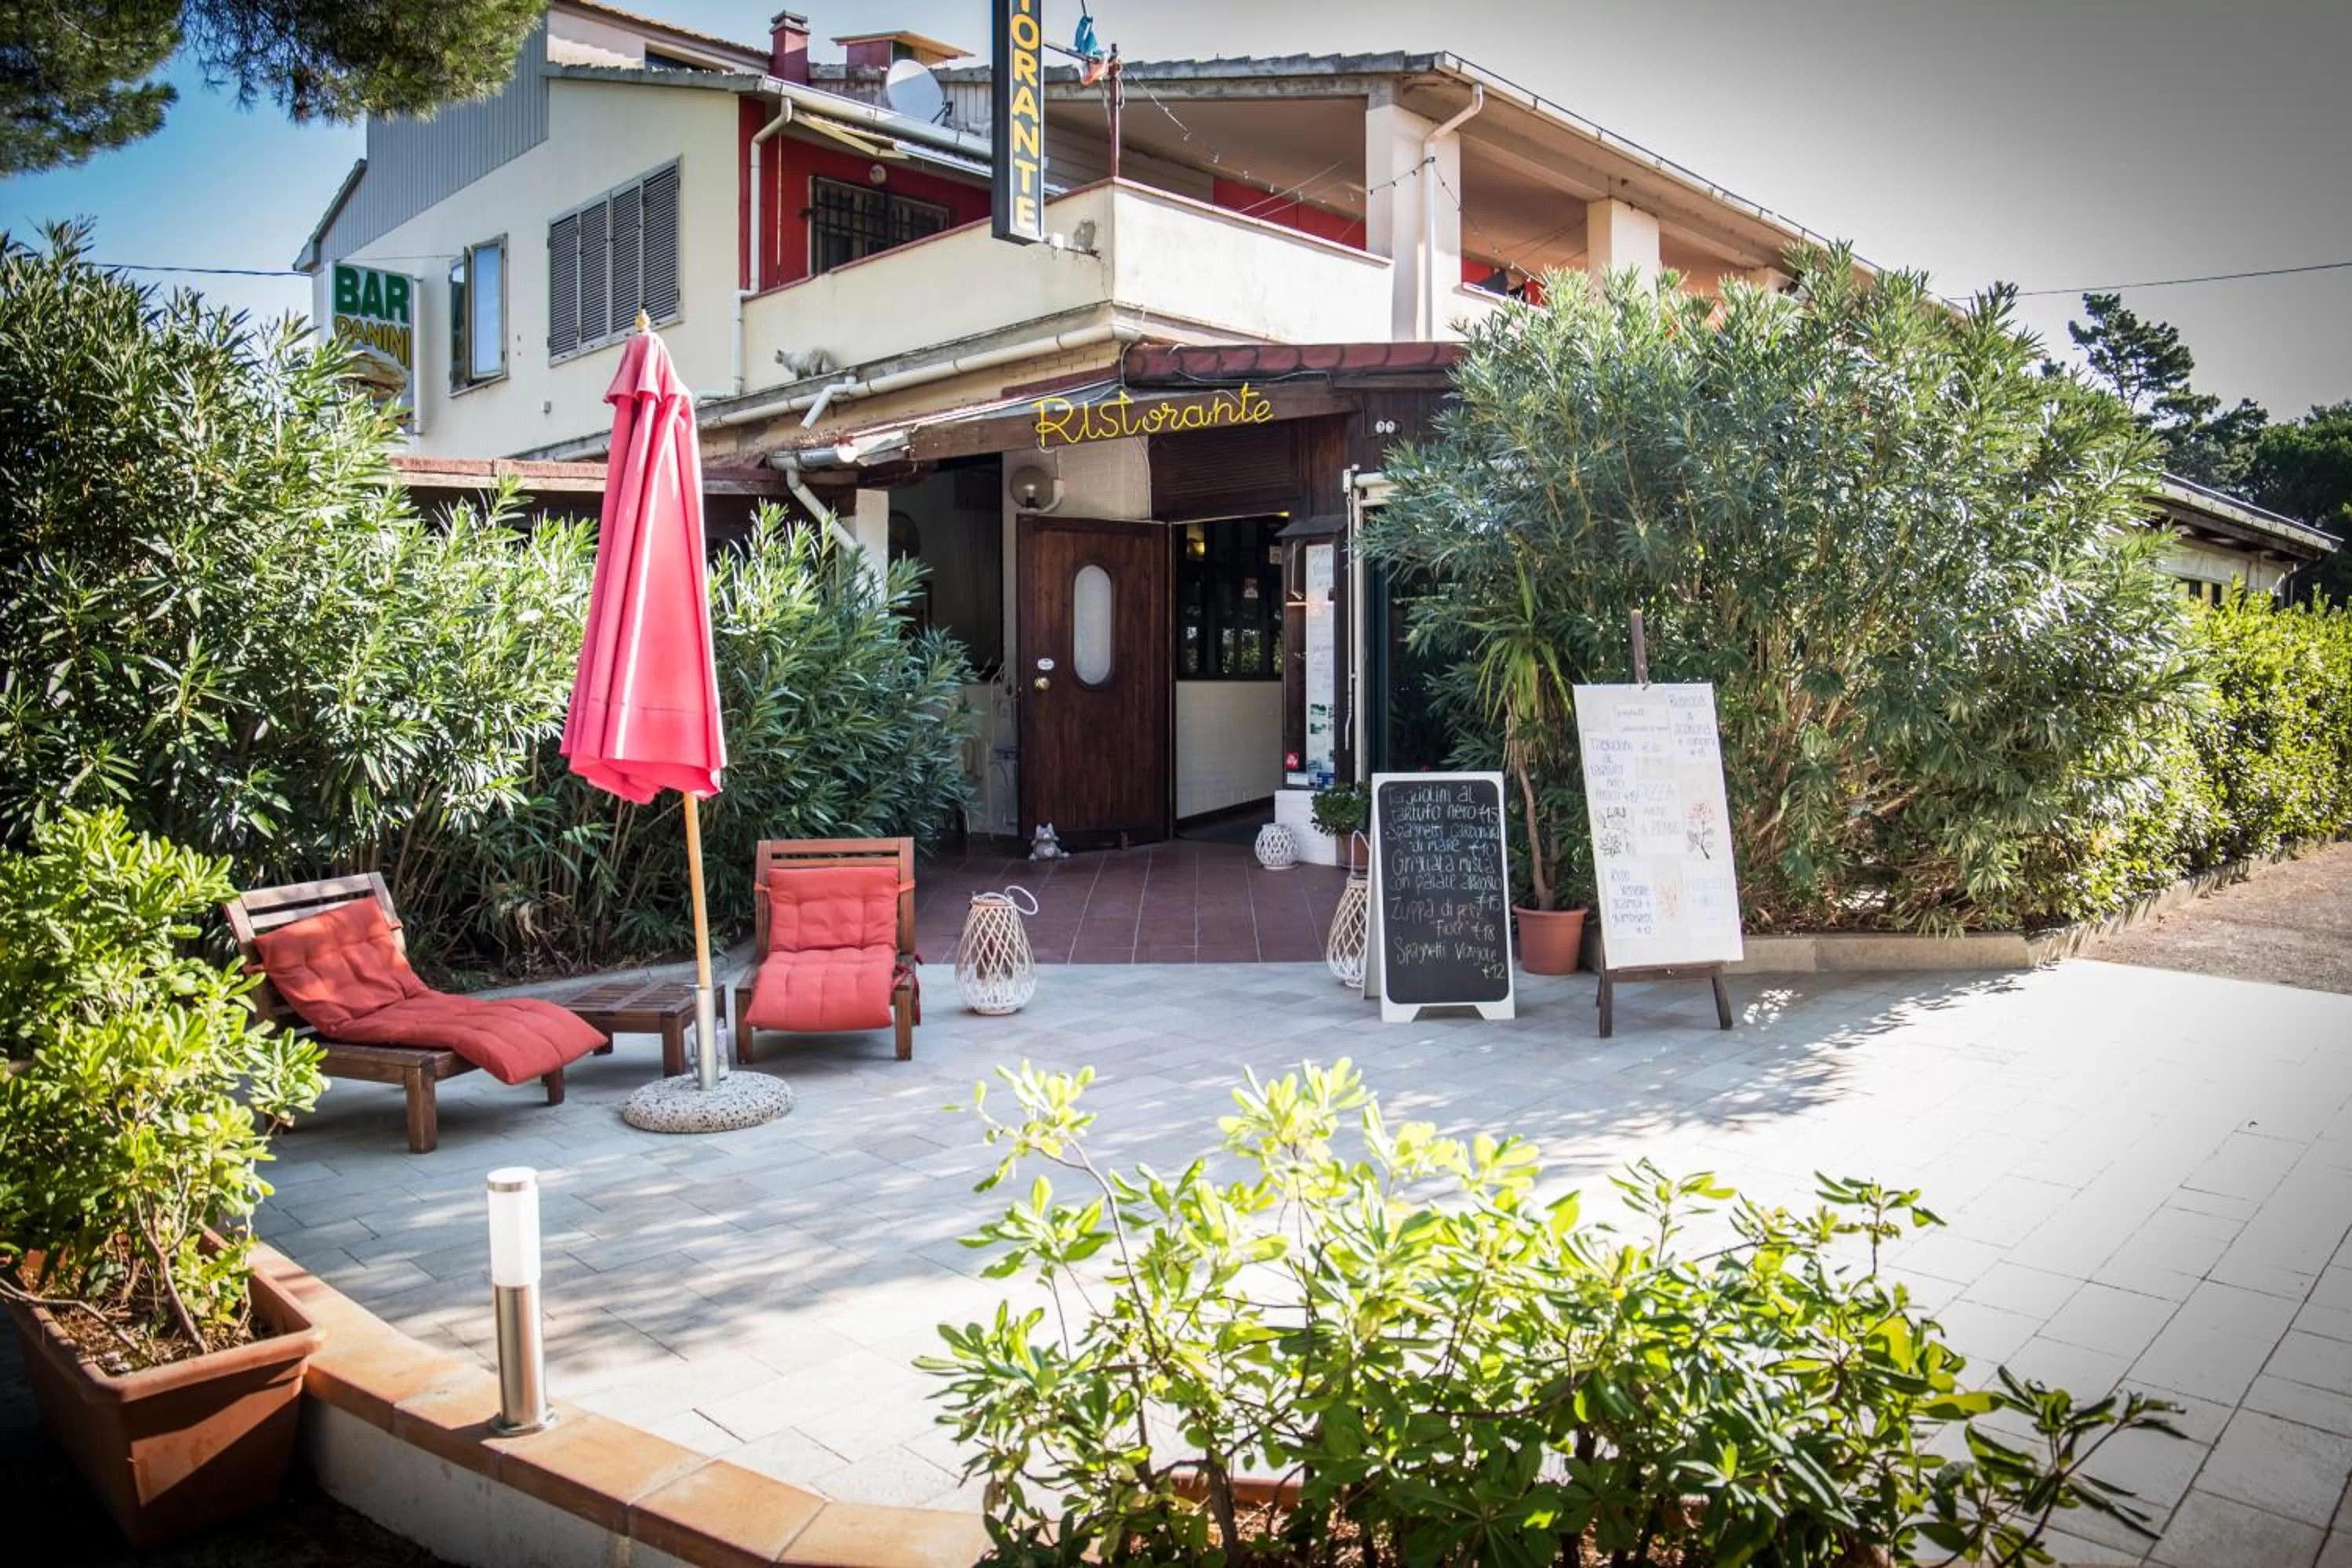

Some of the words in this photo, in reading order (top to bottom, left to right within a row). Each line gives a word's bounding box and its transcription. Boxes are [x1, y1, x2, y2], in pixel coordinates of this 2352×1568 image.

[335, 266, 410, 323] BAR
[334, 315, 411, 370] PANINI
[1032, 382, 1274, 447] Ristorante
[1457, 784, 1475, 803] al
[1447, 804, 1476, 820] nero
[1388, 874, 1410, 892] con
[1389, 896, 1435, 923] Zuppa
[1440, 896, 1454, 916] di
